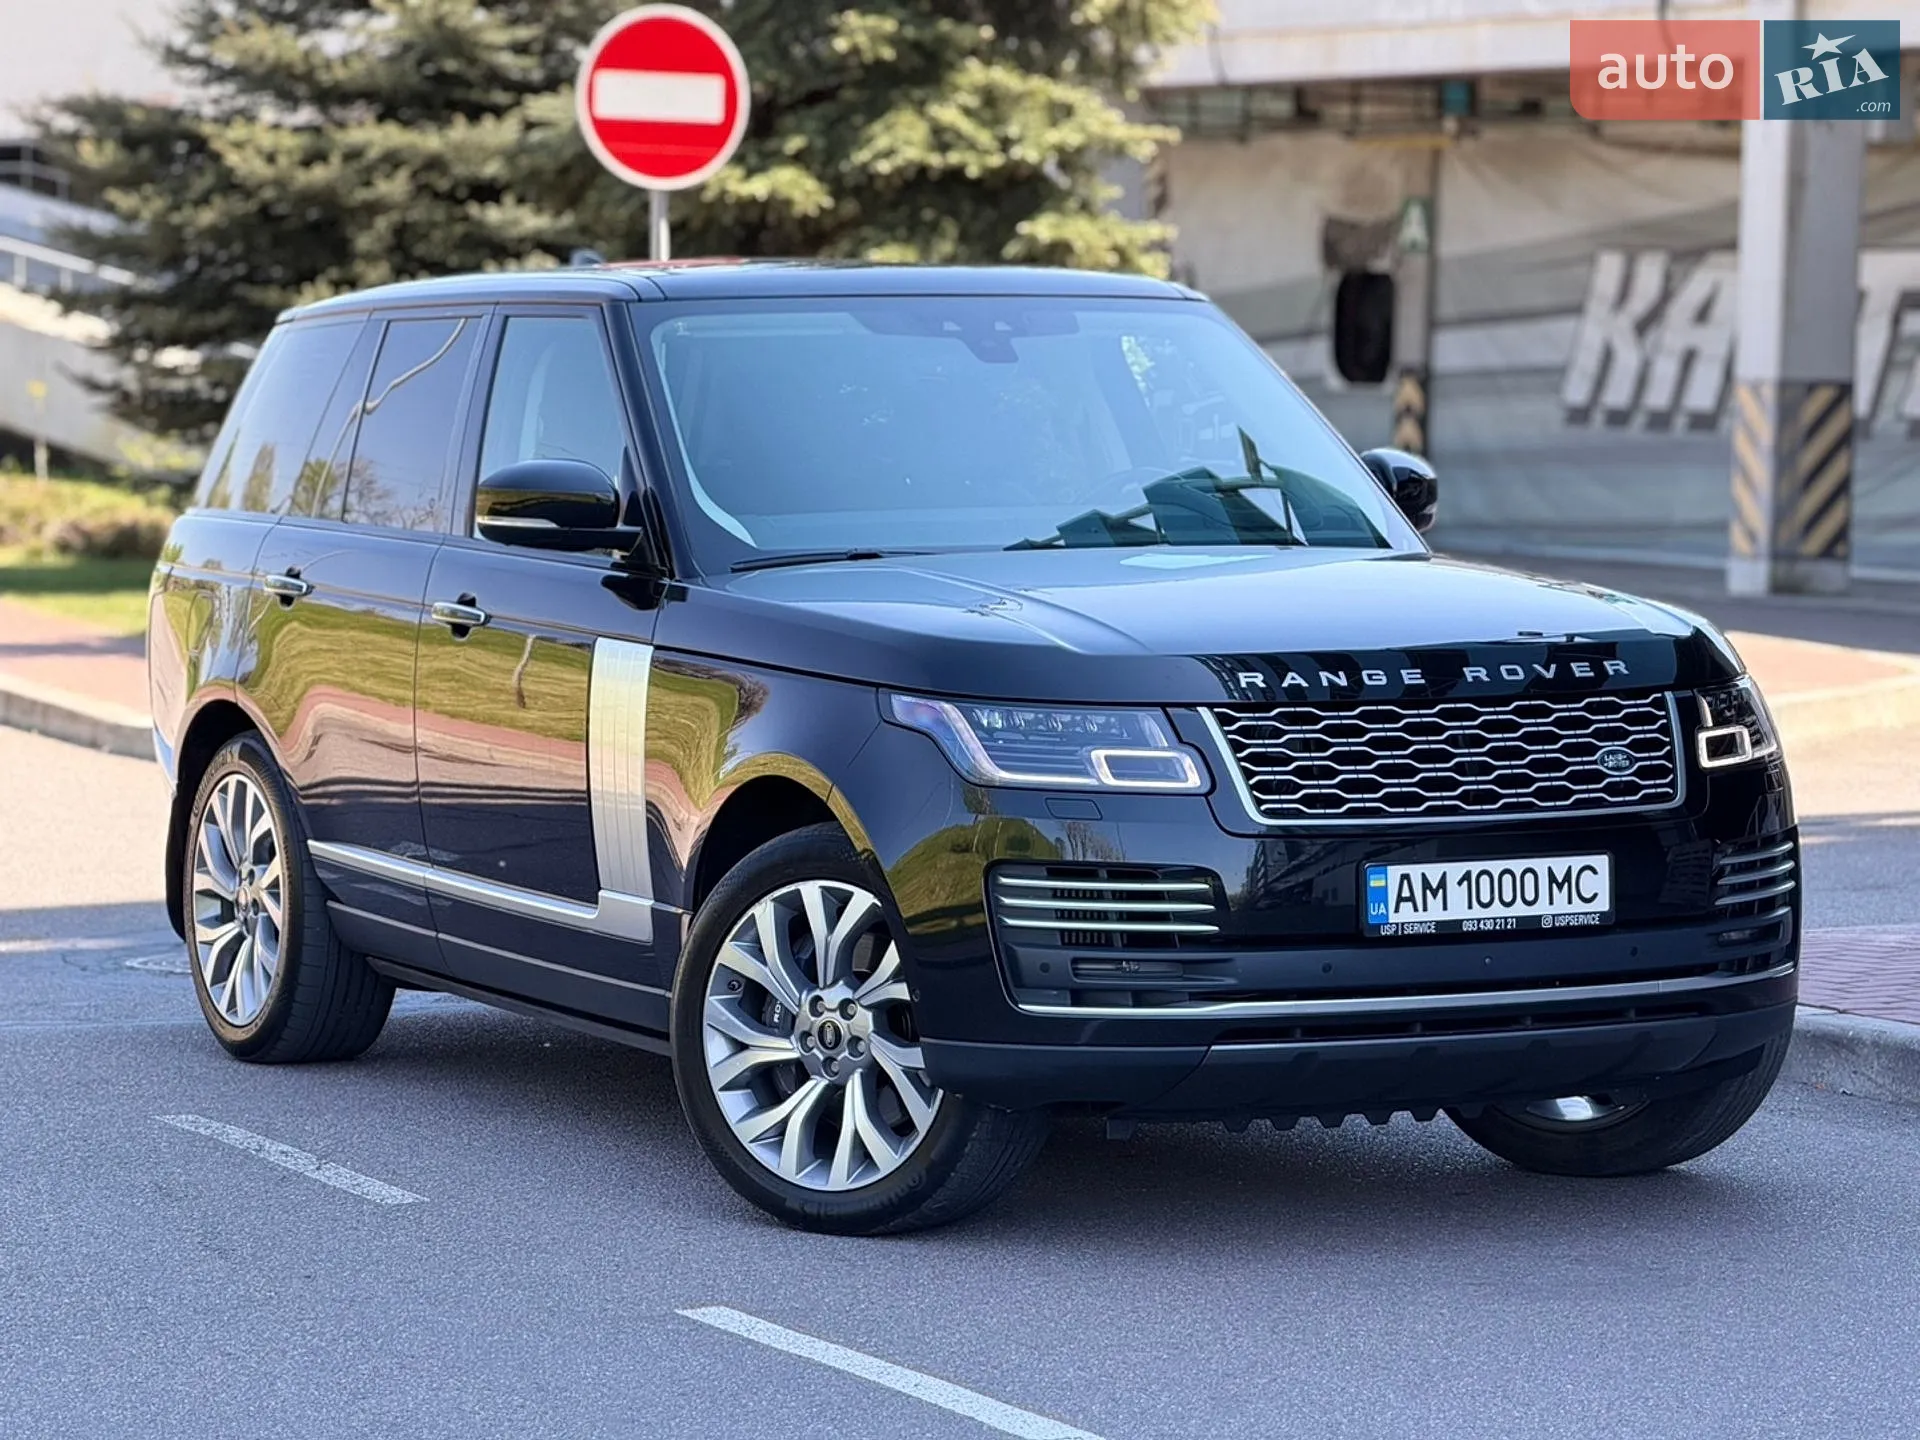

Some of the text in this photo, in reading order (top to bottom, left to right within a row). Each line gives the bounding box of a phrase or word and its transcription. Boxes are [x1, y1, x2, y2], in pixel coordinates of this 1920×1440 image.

[1238, 659, 1630, 690] RANGE ROVER
[1393, 864, 1599, 914] AM 1000 MC
[1370, 902, 1387, 915] UA
[1462, 917, 1517, 931] 093 430 21 21
[1554, 913, 1600, 927] USPSERVICE
[1380, 924, 1397, 936] USP
[1403, 921, 1437, 934] SERVICE
